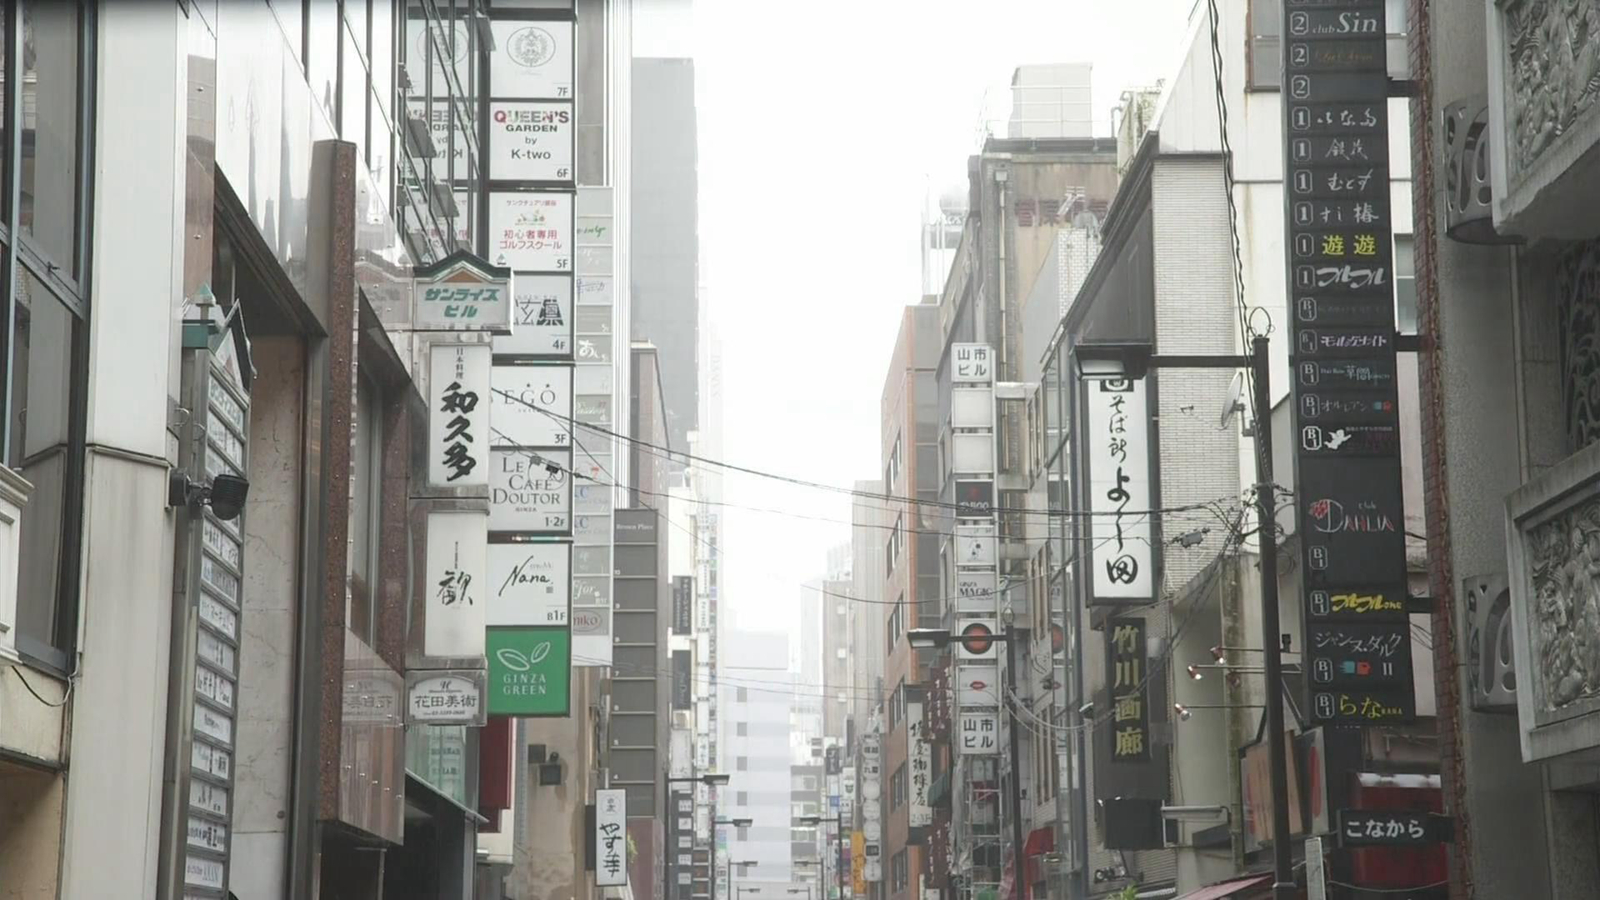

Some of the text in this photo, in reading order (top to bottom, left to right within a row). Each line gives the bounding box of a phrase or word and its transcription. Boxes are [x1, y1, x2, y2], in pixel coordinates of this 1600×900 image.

[1312, 12, 1377, 34] club Sin
[557, 87, 568, 97] 7F
[494, 110, 569, 124] QUEEN'S
[506, 124, 558, 132] GARDEN
[525, 136, 538, 146] by
[511, 149, 551, 160] K-two
[557, 168, 569, 178] 6F
[504, 229, 558, 240] 初心者専用
[500, 240, 562, 250] ゴルフスクール
[557, 259, 569, 269] 5F
[425, 287, 500, 302] サンライズ
[444, 304, 478, 318] ビル
[553, 340, 566, 350] 4F
[958, 348, 987, 361] 山市
[958, 364, 987, 377] ビル
[554, 434, 567, 444] 3F
[493, 489, 561, 505] DOUTOR
[547, 610, 566, 621] B1F
[503, 673, 546, 684] GINZA
[503, 685, 546, 695] GREEN
[963, 718, 994, 732] 山市
[963, 735, 994, 749] ビル
[1347, 819, 1425, 839] こなから
